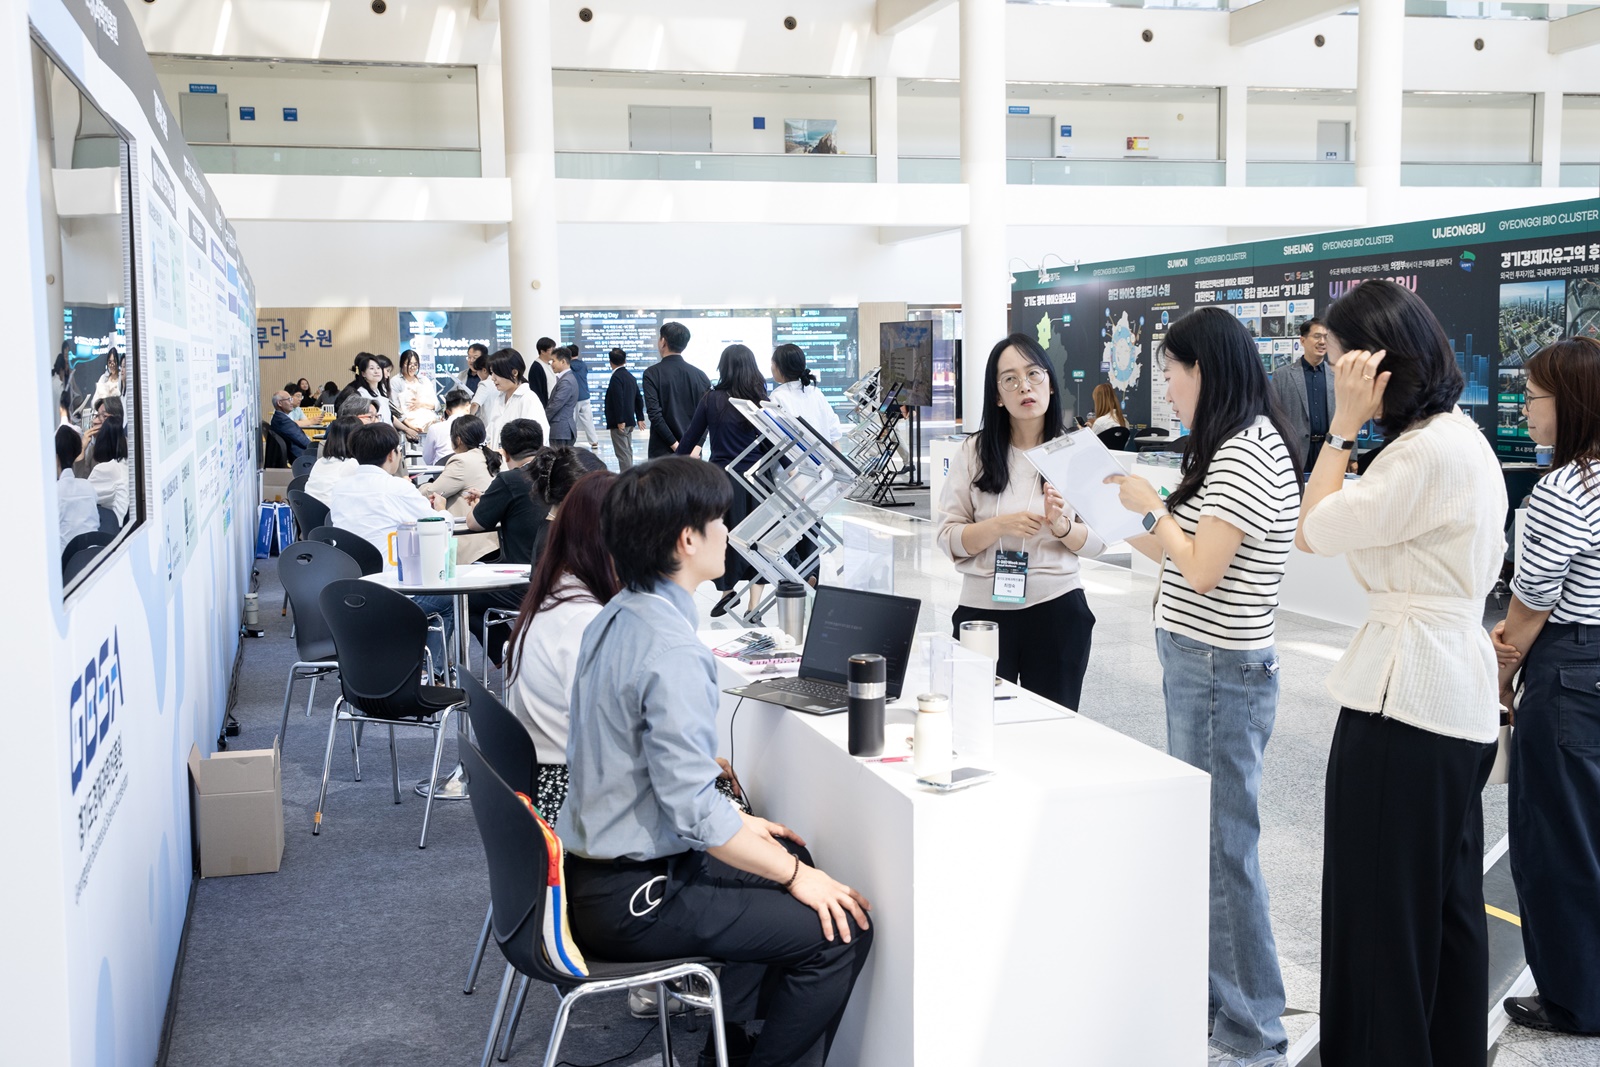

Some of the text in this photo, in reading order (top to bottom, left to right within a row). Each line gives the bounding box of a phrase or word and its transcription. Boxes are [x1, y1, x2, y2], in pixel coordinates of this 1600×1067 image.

[1498, 210, 1599, 231] GYEONGGI BIO CLUSTER
[1432, 222, 1486, 239] UIJEONGBU
[1283, 243, 1314, 256] SIHEUNG
[1322, 234, 1394, 251] GYEONGGI BIO CLUSTER
[1167, 258, 1188, 269] SUWON
[1194, 252, 1247, 265] GYEONGGI BIO CLUSTER
[1500, 245, 1586, 268] 경기경제자유구역
[1500, 271, 1514, 279] 외국인
[1537, 266, 1572, 277] 국내복귀기업의
[1573, 264, 1600, 274] 국내투자를
[1024, 296, 1036, 307] 경기도
[1046, 292, 1076, 305] 바이오클러스터
[1119, 287, 1135, 300] 바이오
[1136, 285, 1158, 298] 융합도시
[1158, 284, 1170, 297] 수원
[1195, 291, 1215, 302] 대한민국
[1216, 290, 1223, 301] AI
[1227, 288, 1243, 300] 바이오
[1244, 287, 1256, 299] 융합
[1256, 285, 1280, 298] 클러스터
[299, 329, 332, 348] 수원
[440, 337, 468, 348] Week
[70, 624, 124, 796] GBSA
